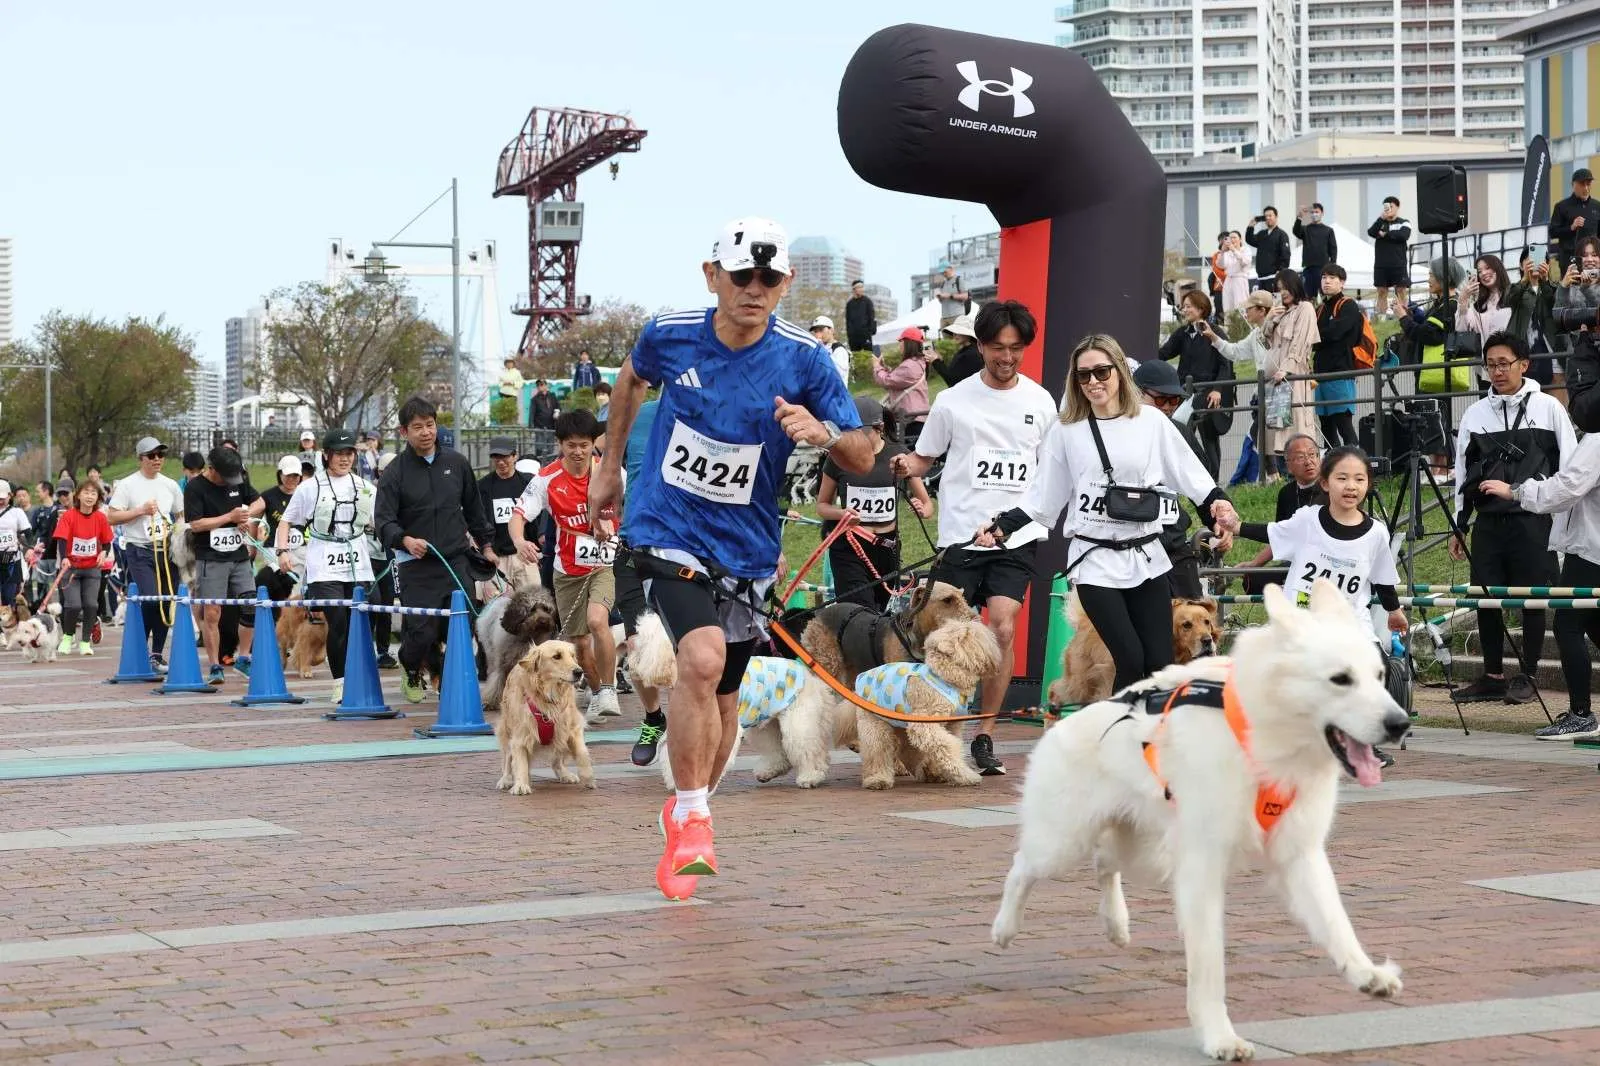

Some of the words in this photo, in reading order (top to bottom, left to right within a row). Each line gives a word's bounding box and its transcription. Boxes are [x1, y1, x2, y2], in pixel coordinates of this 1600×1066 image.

[949, 117, 988, 131] UNDER
[988, 123, 1037, 139] ARMOUR
[734, 231, 744, 246] 1
[669, 445, 750, 489] 2424
[977, 460, 1027, 482] 2412
[496, 506, 511, 518] 24
[850, 497, 895, 514] 2420
[1079, 493, 1105, 516] 24
[1163, 499, 1178, 515] 14
[213, 534, 242, 547] 2430
[327, 551, 360, 566] 2432
